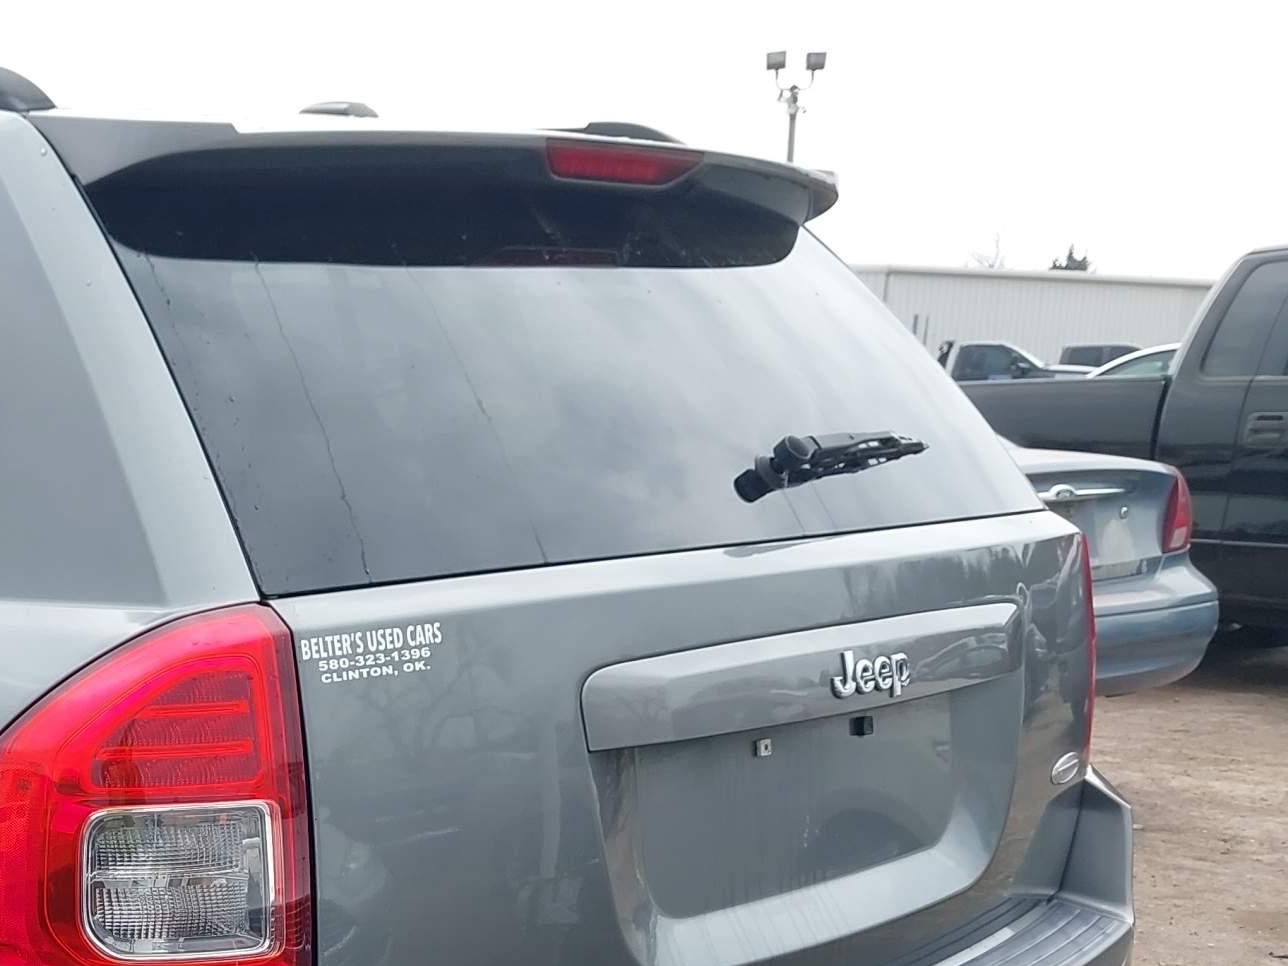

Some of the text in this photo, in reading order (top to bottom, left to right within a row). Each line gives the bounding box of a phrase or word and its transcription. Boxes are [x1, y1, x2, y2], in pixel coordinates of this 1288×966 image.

[300, 622, 443, 660] BELTER'S USED CARS
[318, 646, 431, 672] 580-323-1396
[321, 660, 431, 684] CLINTON, OK.
[831, 650, 911, 699] Jeep
